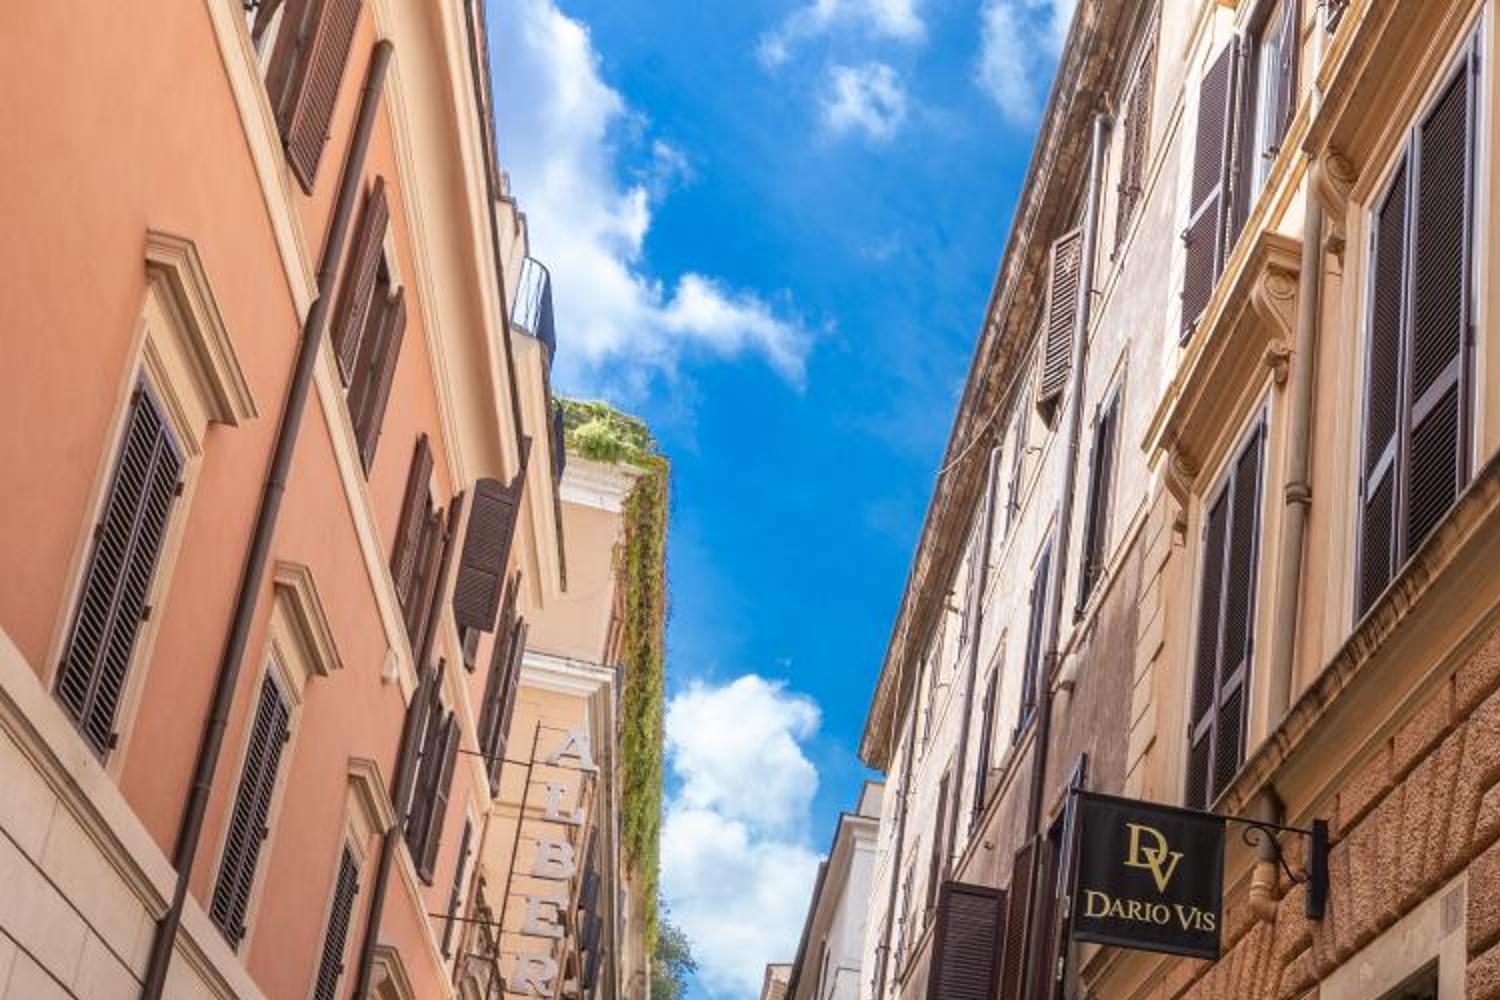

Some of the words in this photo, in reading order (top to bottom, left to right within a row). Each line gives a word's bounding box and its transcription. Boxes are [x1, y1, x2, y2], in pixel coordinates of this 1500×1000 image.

[1123, 823, 1184, 893] DV
[1084, 889, 1171, 925] DARIO
[1174, 903, 1216, 931] VIS
